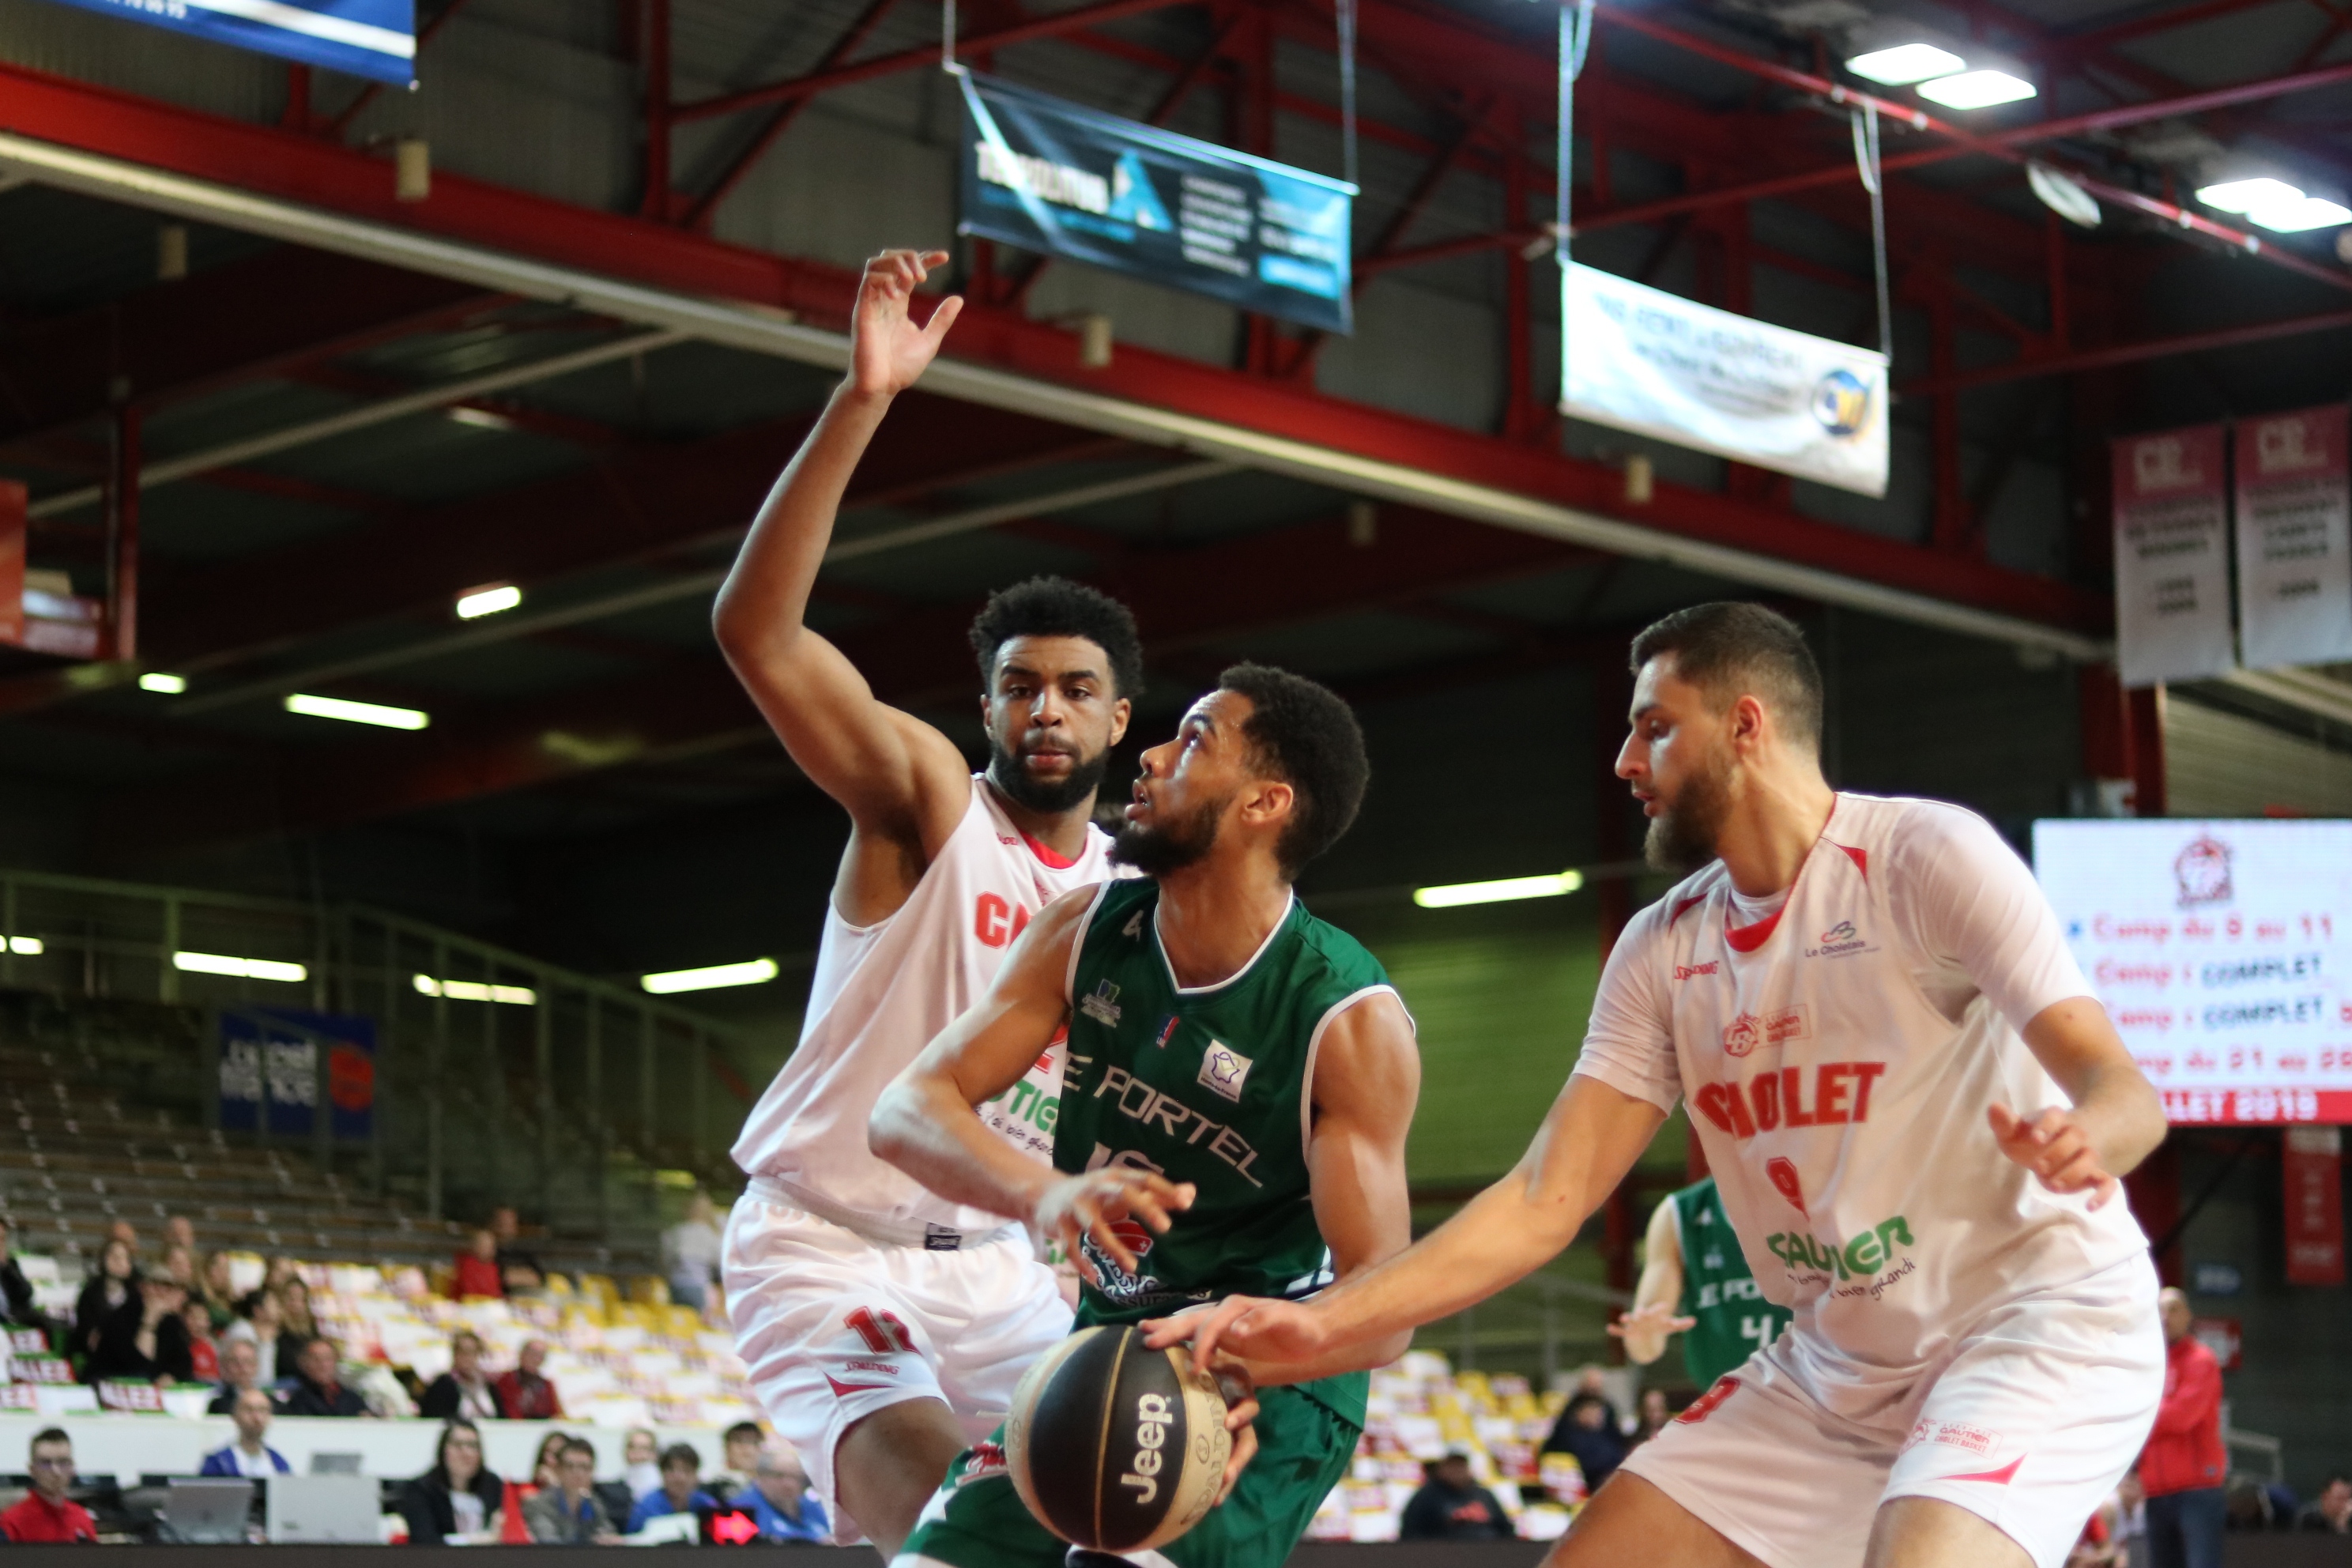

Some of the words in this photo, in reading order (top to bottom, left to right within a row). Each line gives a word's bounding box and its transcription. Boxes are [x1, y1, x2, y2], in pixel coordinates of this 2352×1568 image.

[1804, 946, 1819, 958] Le
[2202, 952, 2324, 986] COMPLET
[2203, 995, 2324, 1030] COMPLET
[1094, 1064, 1264, 1189] PORTEL
[1740, 1314, 1774, 1349] 4
[843, 1360, 901, 1376] SPALDING
[1120, 1392, 1175, 1504] Jeep
[1960, 1438, 1988, 1453] BASKET
